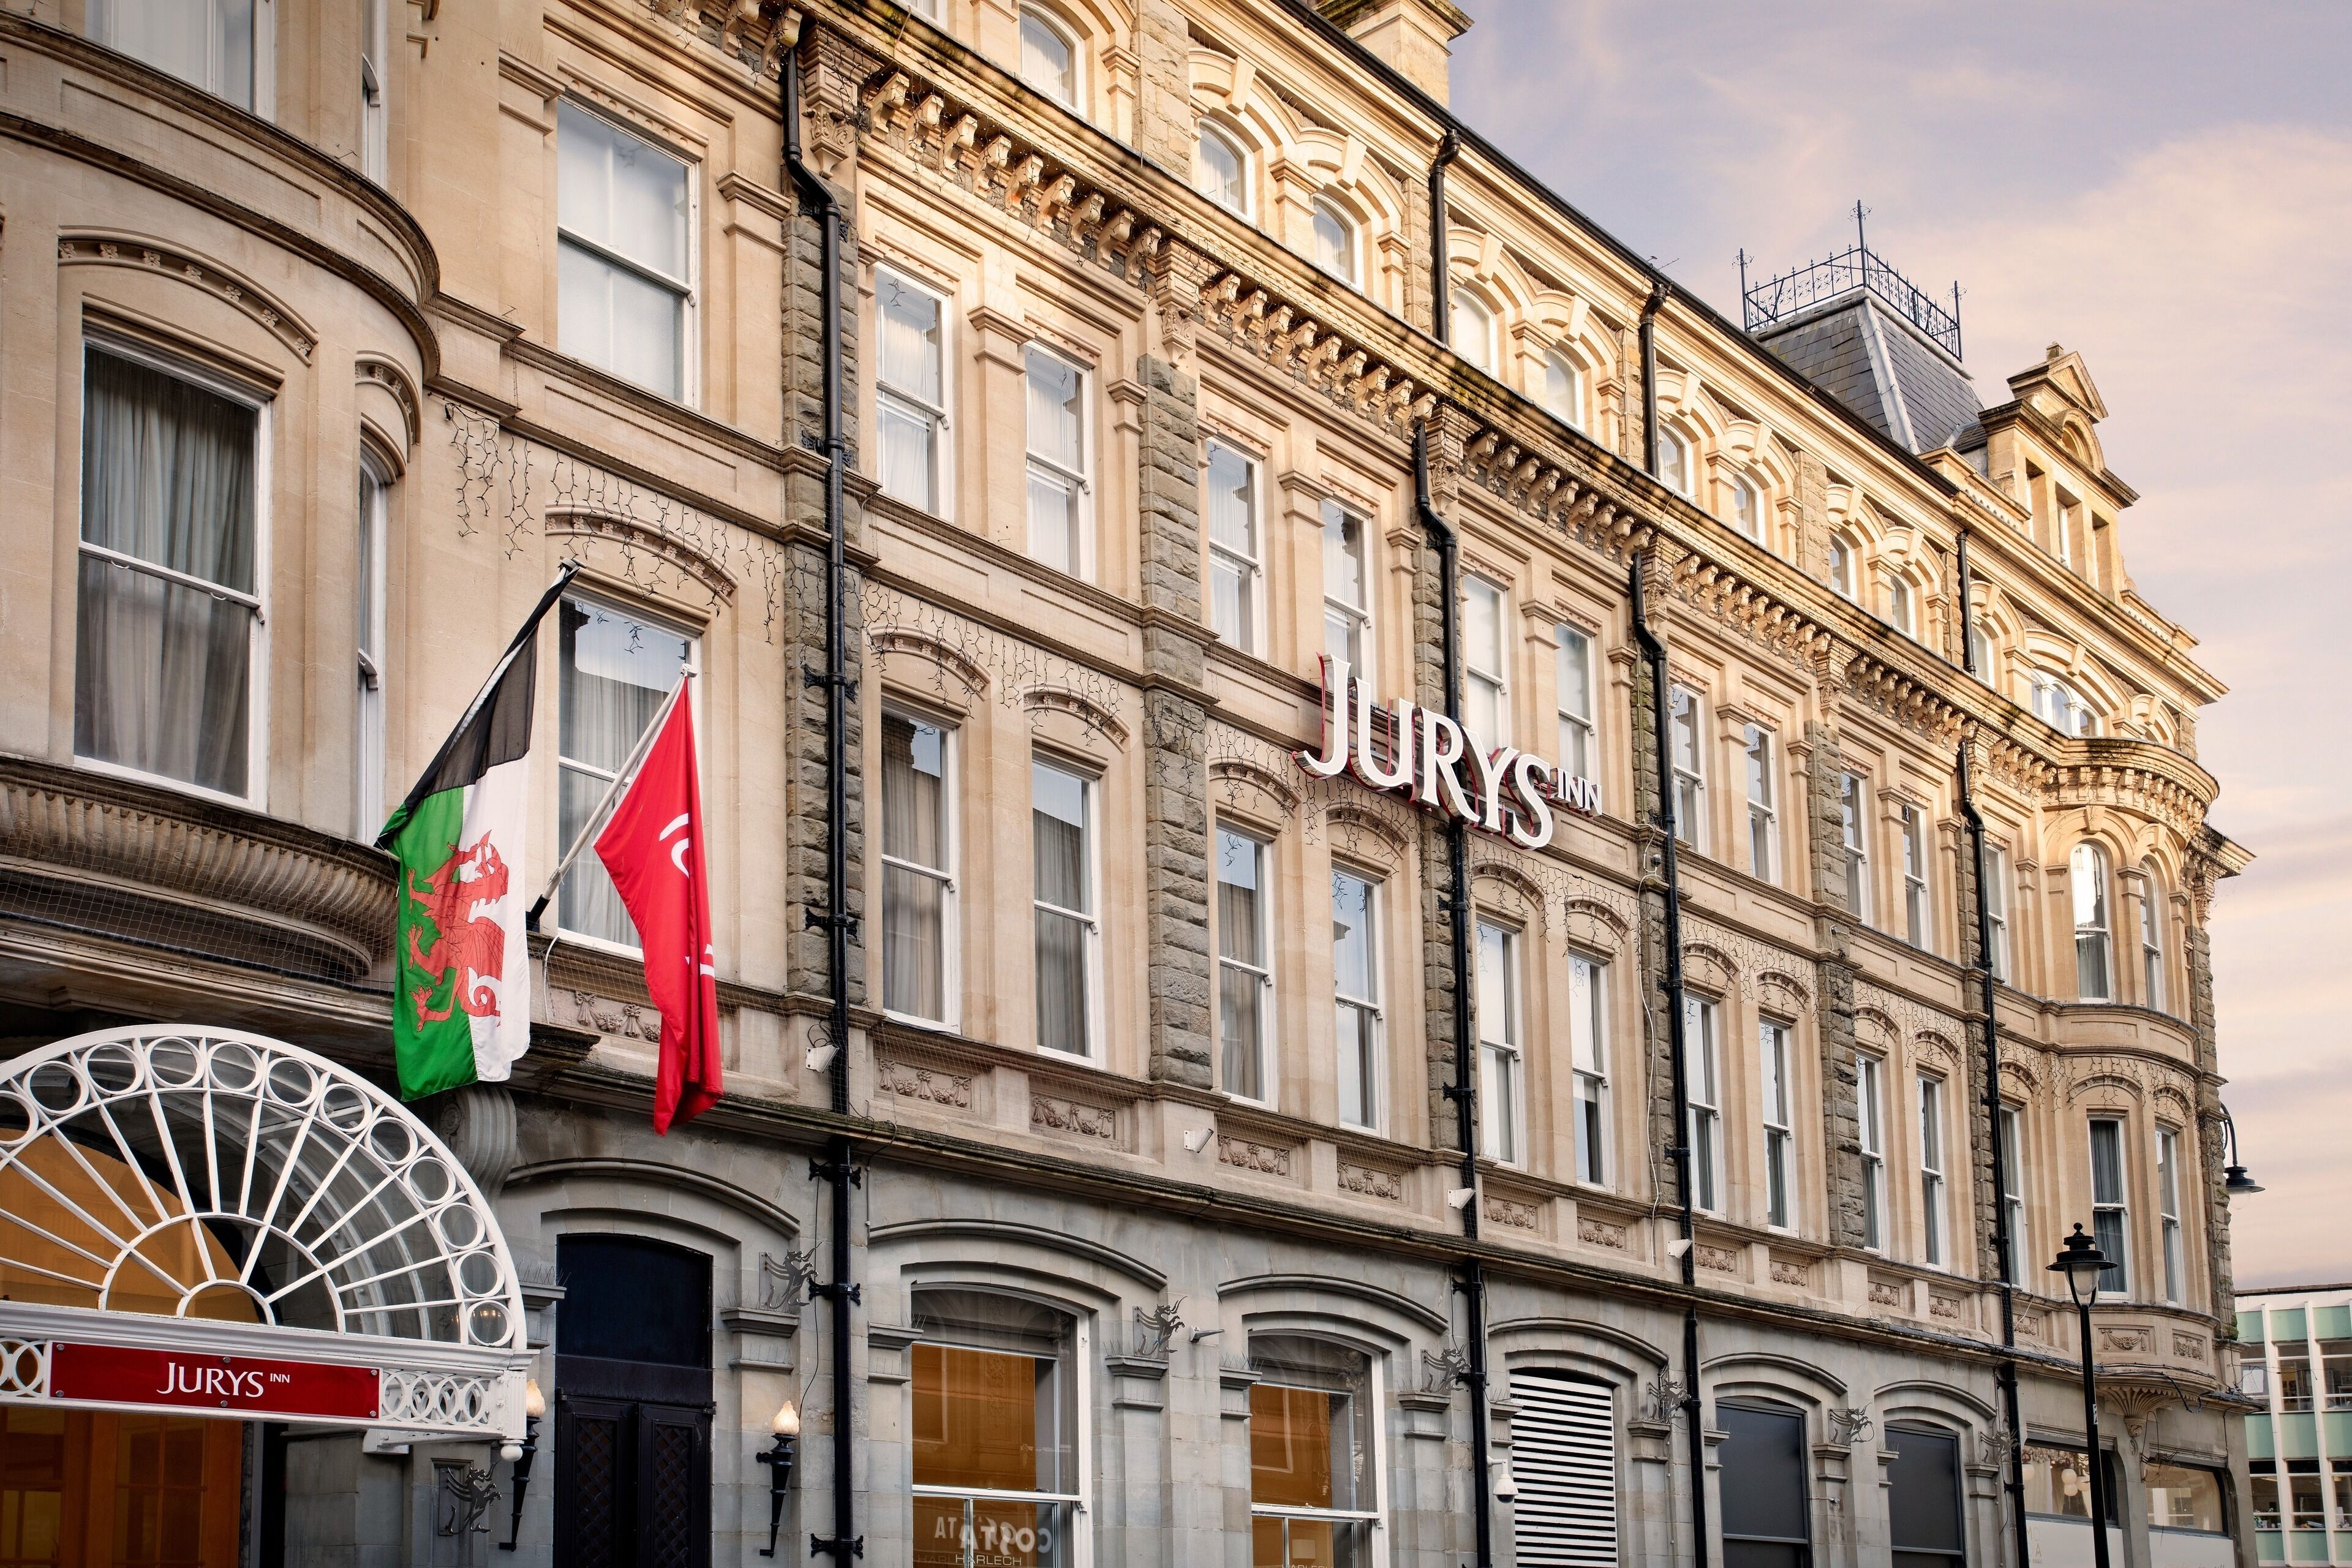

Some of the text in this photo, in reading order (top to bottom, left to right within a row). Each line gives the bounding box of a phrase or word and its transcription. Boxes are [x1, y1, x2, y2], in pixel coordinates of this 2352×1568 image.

[1292, 652, 1602, 850] JURYS INN
[156, 1362, 290, 1398] JURYS INN
[955, 1554, 1022, 1566] HARLECH
